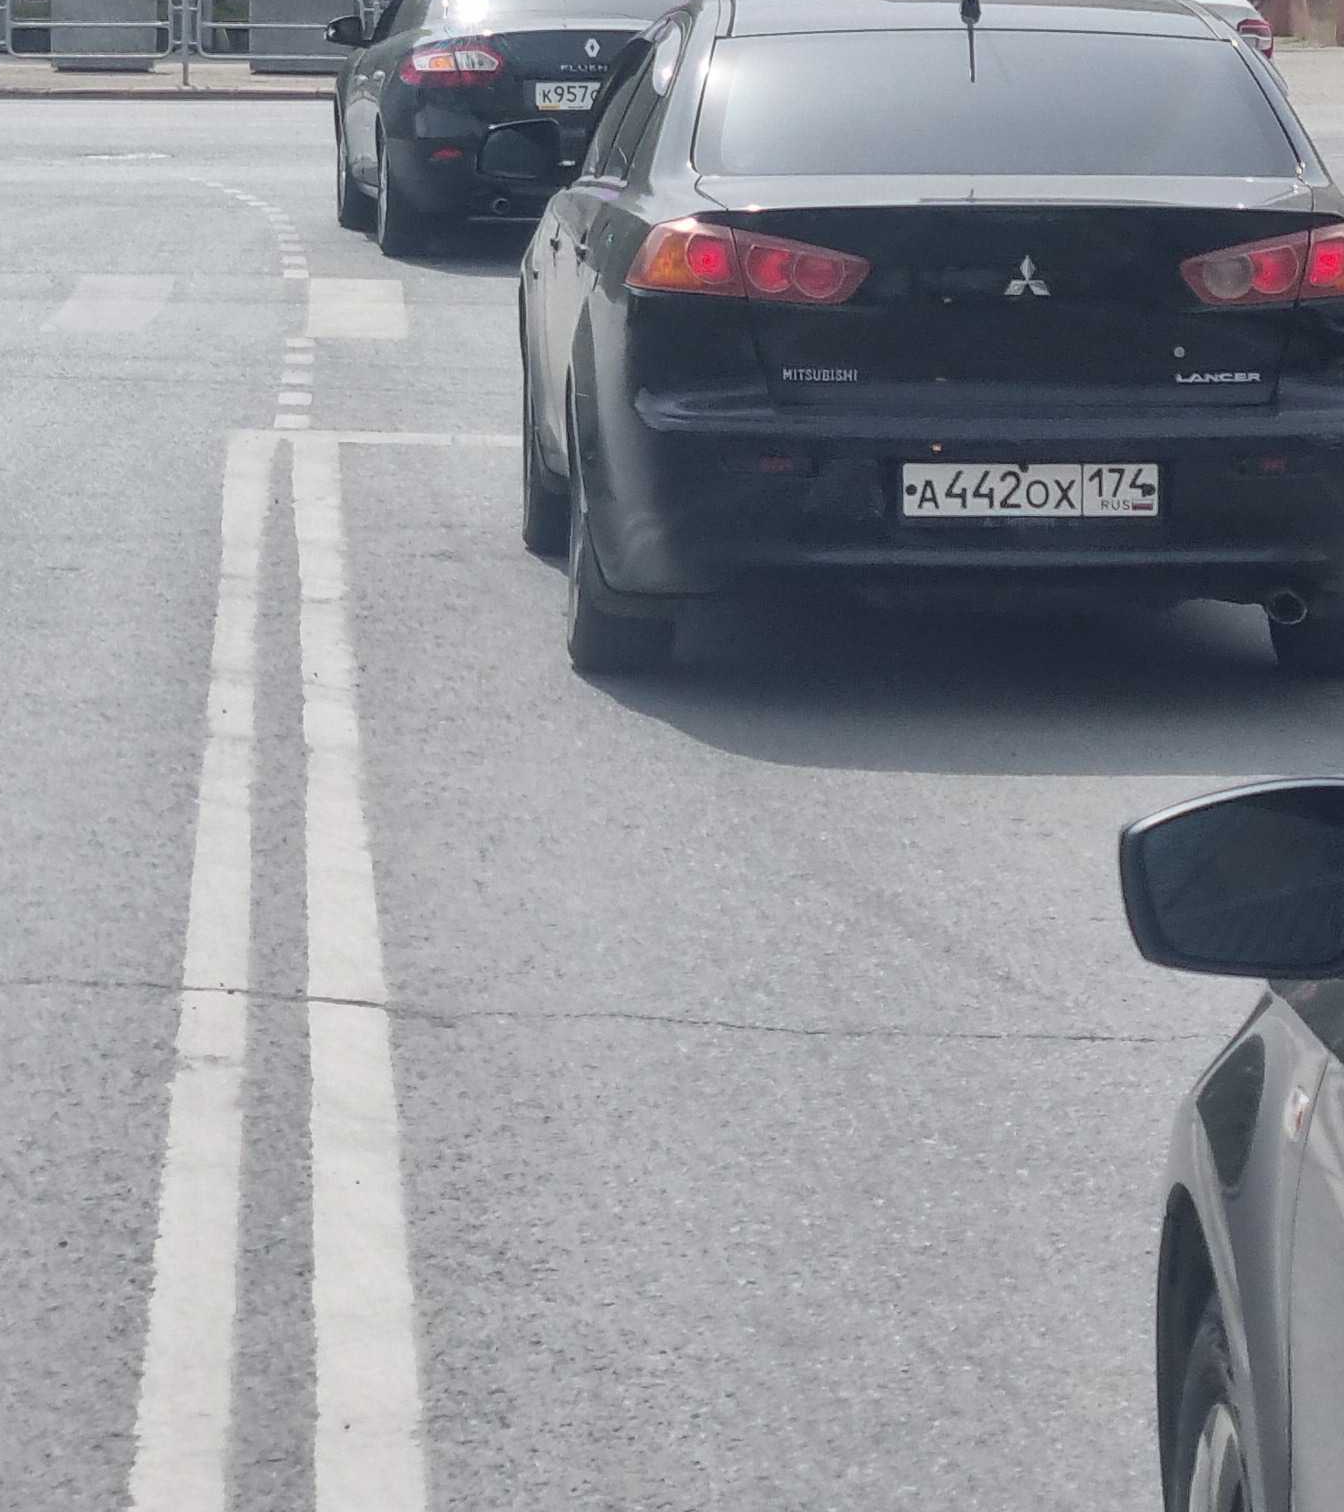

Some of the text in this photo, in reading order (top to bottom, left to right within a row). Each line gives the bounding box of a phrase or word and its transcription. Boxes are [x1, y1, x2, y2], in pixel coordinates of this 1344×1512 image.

[782, 368, 858, 382] MITSUBISHI
[1175, 372, 1261, 383] LANCER
[1088, 467, 1156, 497] 174
[1100, 500, 1131, 511] RUS
